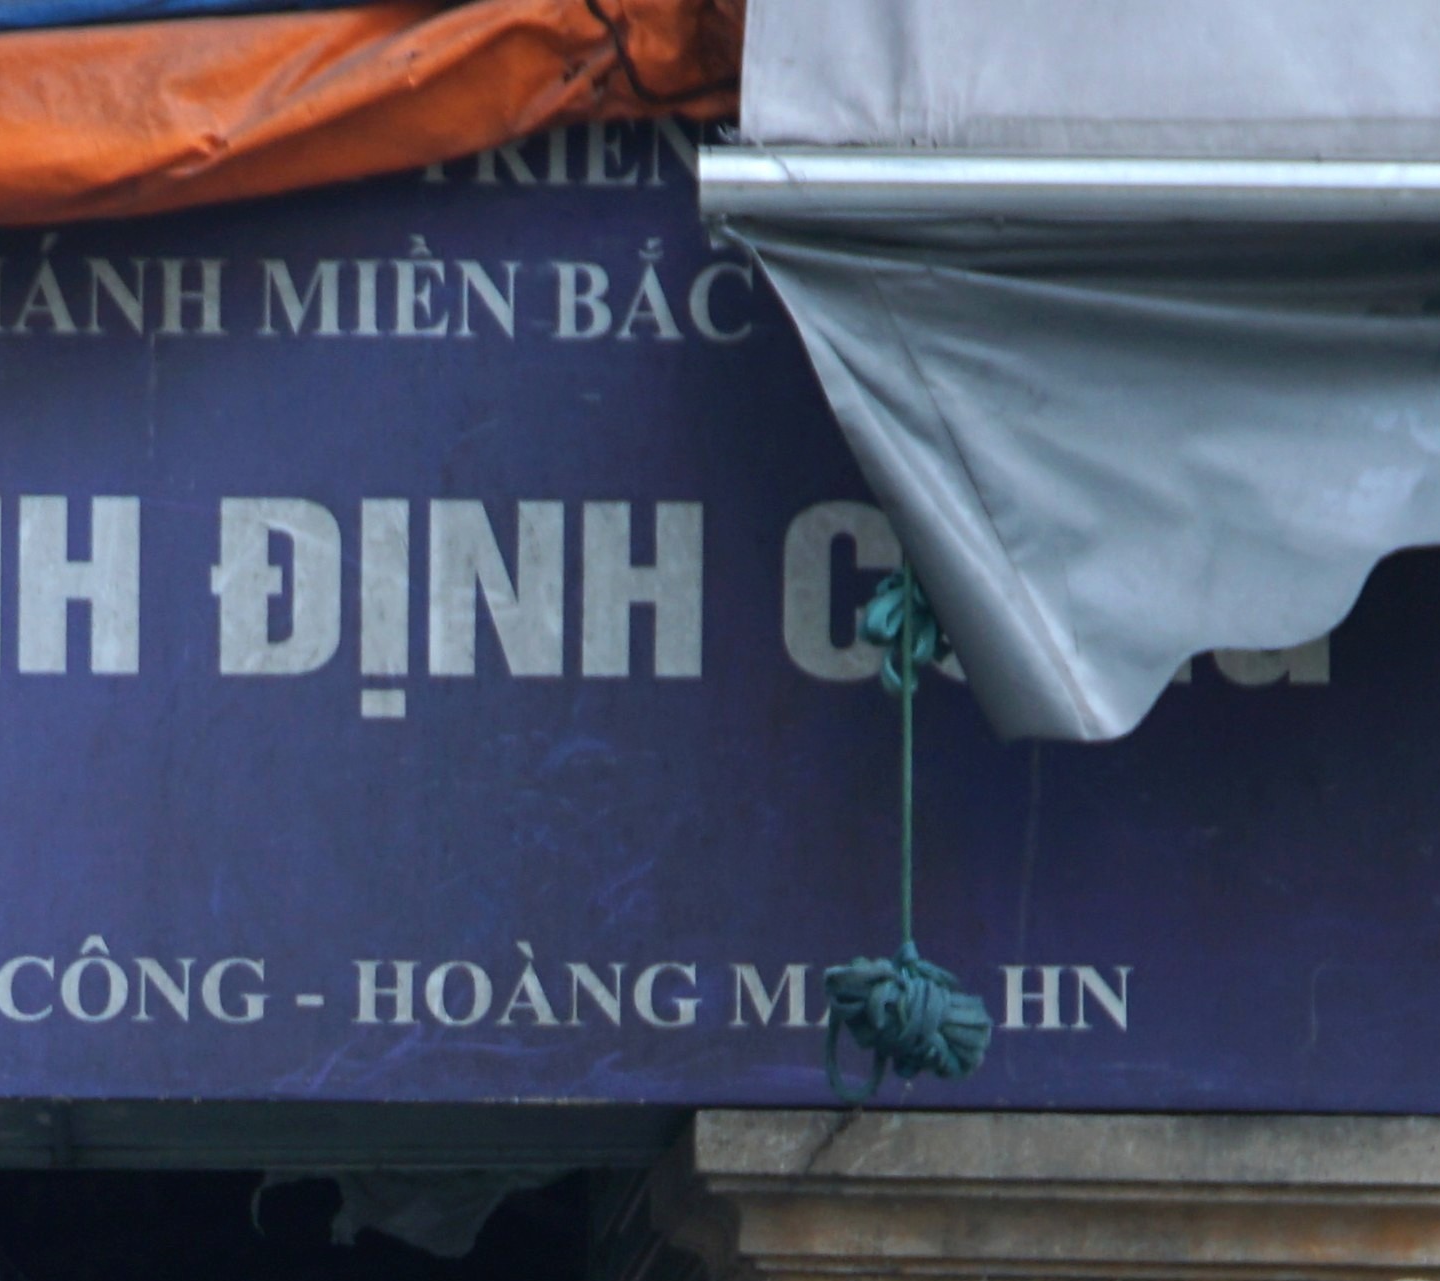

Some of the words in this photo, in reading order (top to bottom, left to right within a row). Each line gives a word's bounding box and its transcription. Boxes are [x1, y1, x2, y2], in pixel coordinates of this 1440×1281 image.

[259, 235, 522, 340] MIỀN
[551, 237, 756, 344] BẮC
[211, 498, 704, 720] ĐỊNH
[350, 944, 701, 1031] HOÀNG
[999, 963, 1135, 1033] HN
